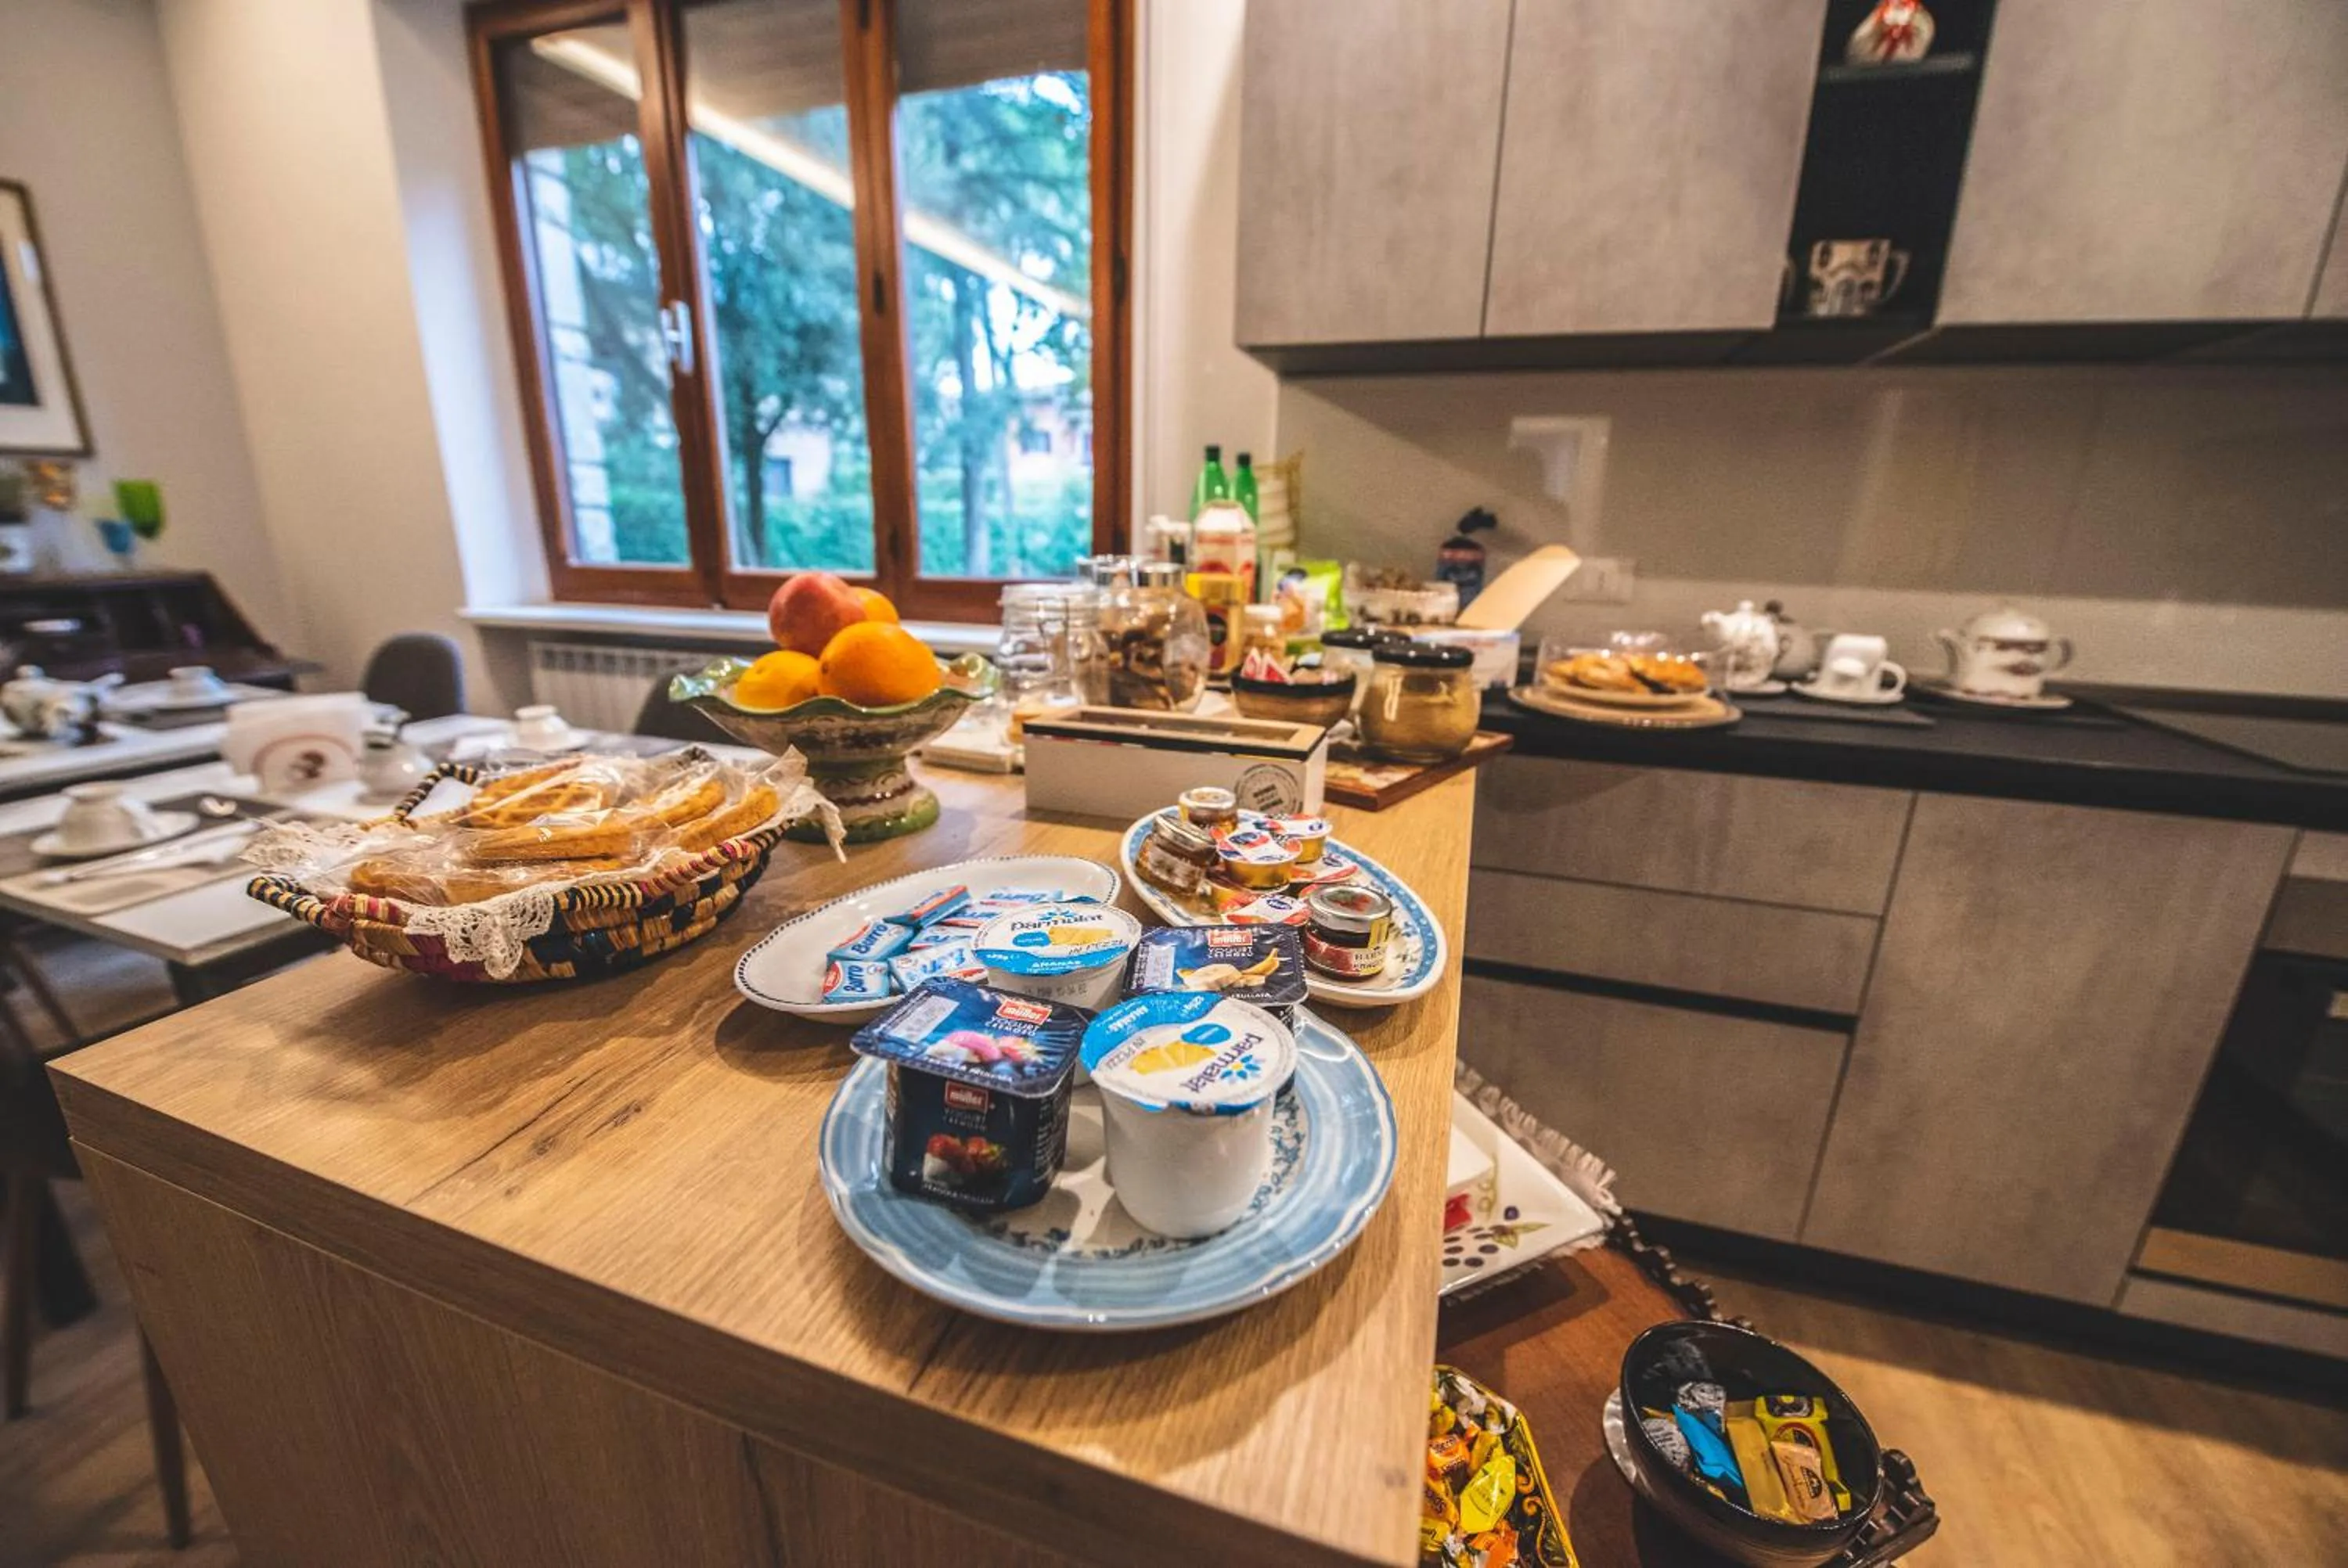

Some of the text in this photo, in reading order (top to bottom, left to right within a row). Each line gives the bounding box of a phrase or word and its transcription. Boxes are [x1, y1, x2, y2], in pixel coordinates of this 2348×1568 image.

[851, 923, 889, 955] Burro
[843, 964, 867, 993] Burro
[1179, 1032, 1263, 1093] parmalat
[949, 1089, 984, 1106] müller
